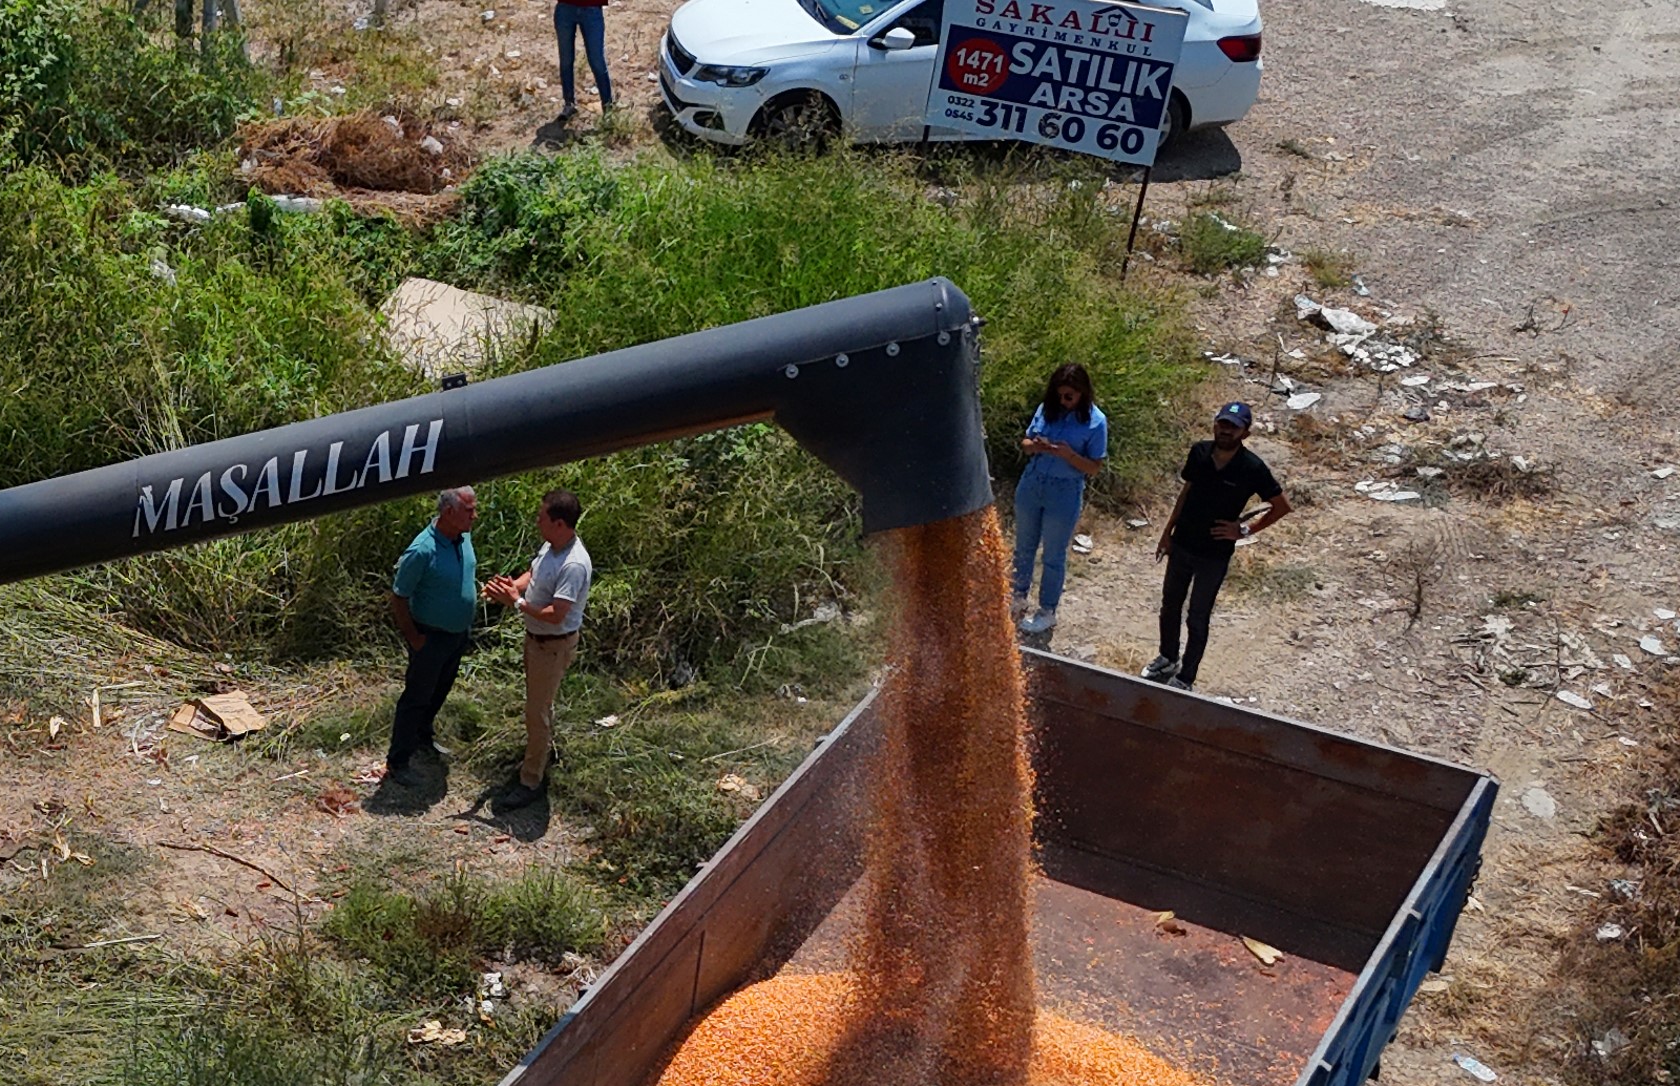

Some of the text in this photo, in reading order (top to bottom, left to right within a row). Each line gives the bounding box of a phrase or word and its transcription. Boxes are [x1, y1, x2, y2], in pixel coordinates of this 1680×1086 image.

[956, 47, 1005, 74] 1471
[1008, 41, 1170, 100] SATILIK
[963, 72, 990, 87] m2
[944, 107, 974, 122] 0545
[947, 95, 975, 109] 0322
[1028, 81, 1136, 123] ARSA
[975, 99, 1145, 155] 311 60 60
[131, 418, 444, 539] MAŞALLAH
